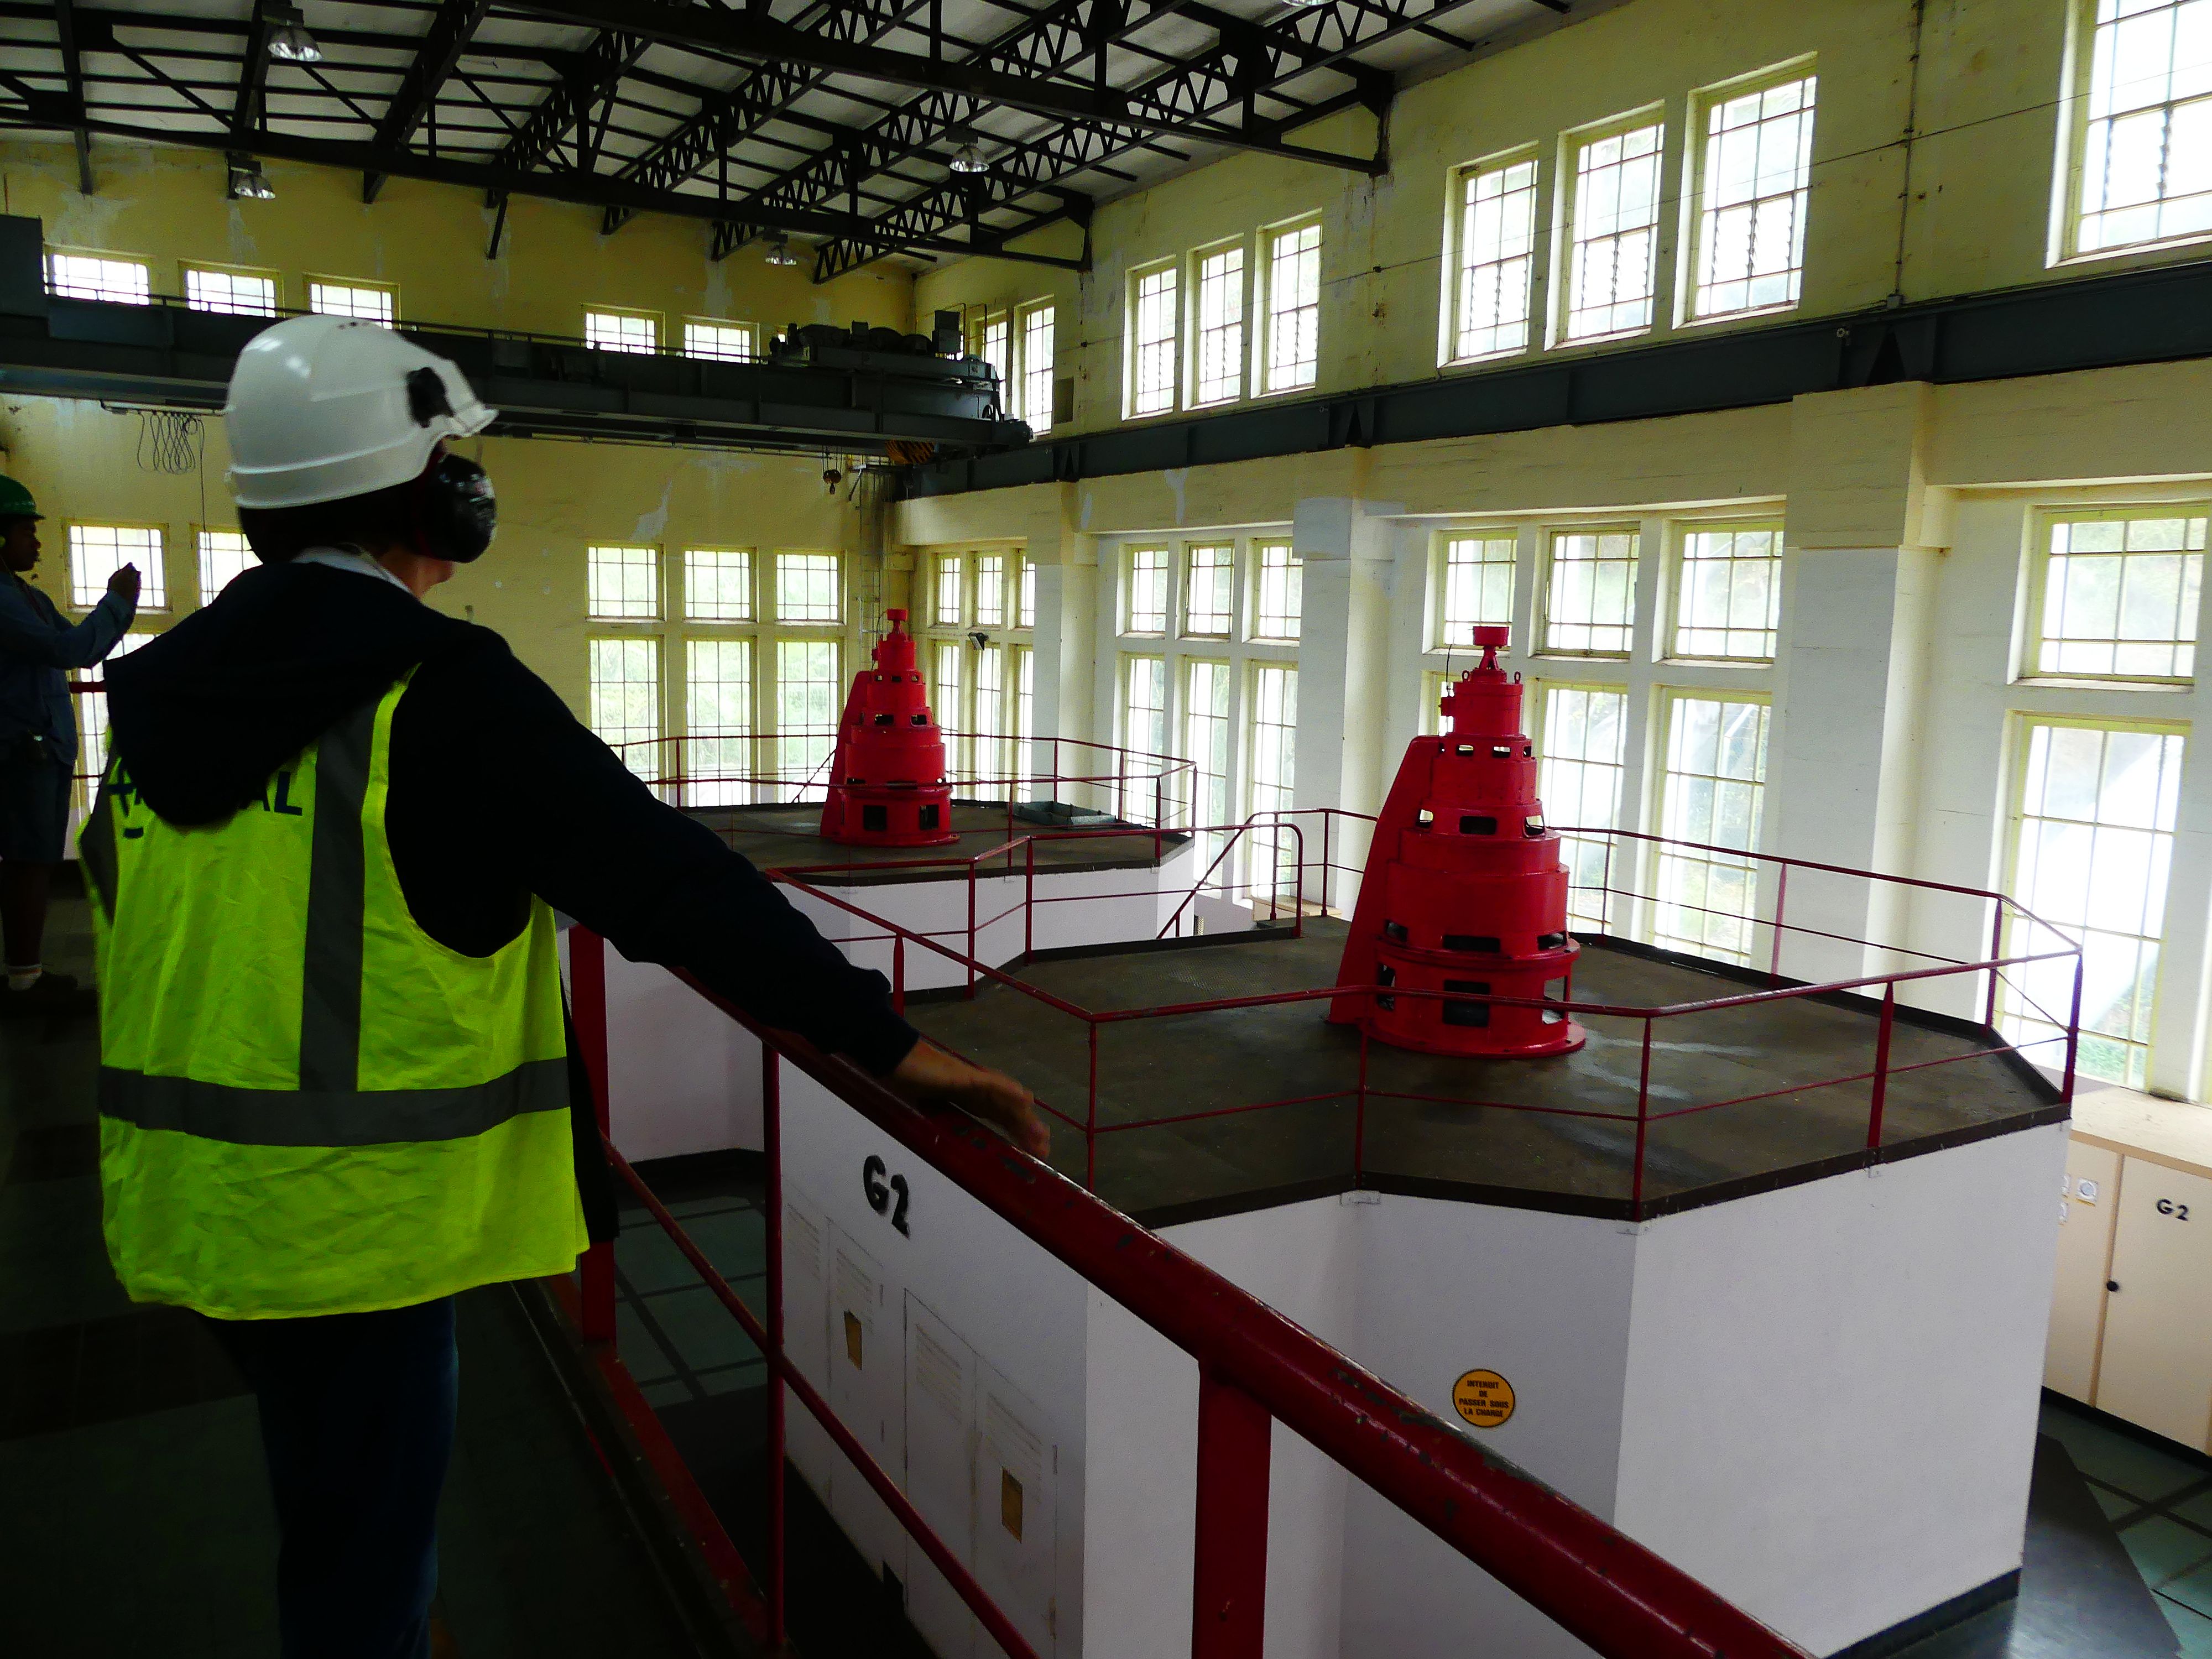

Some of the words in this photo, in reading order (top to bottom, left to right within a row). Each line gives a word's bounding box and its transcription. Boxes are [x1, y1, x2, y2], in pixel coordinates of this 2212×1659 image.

[863, 1155, 910, 1239] G2
[2157, 1199, 2188, 1221] G2
[1467, 1380, 1499, 1389] INTERDIT
[1459, 1398, 1486, 1407] PASSER
[1490, 1400, 1509, 1408] SOUS
[1464, 1407, 1473, 1415] LA
[1475, 1408, 1503, 1417] CHARGE
